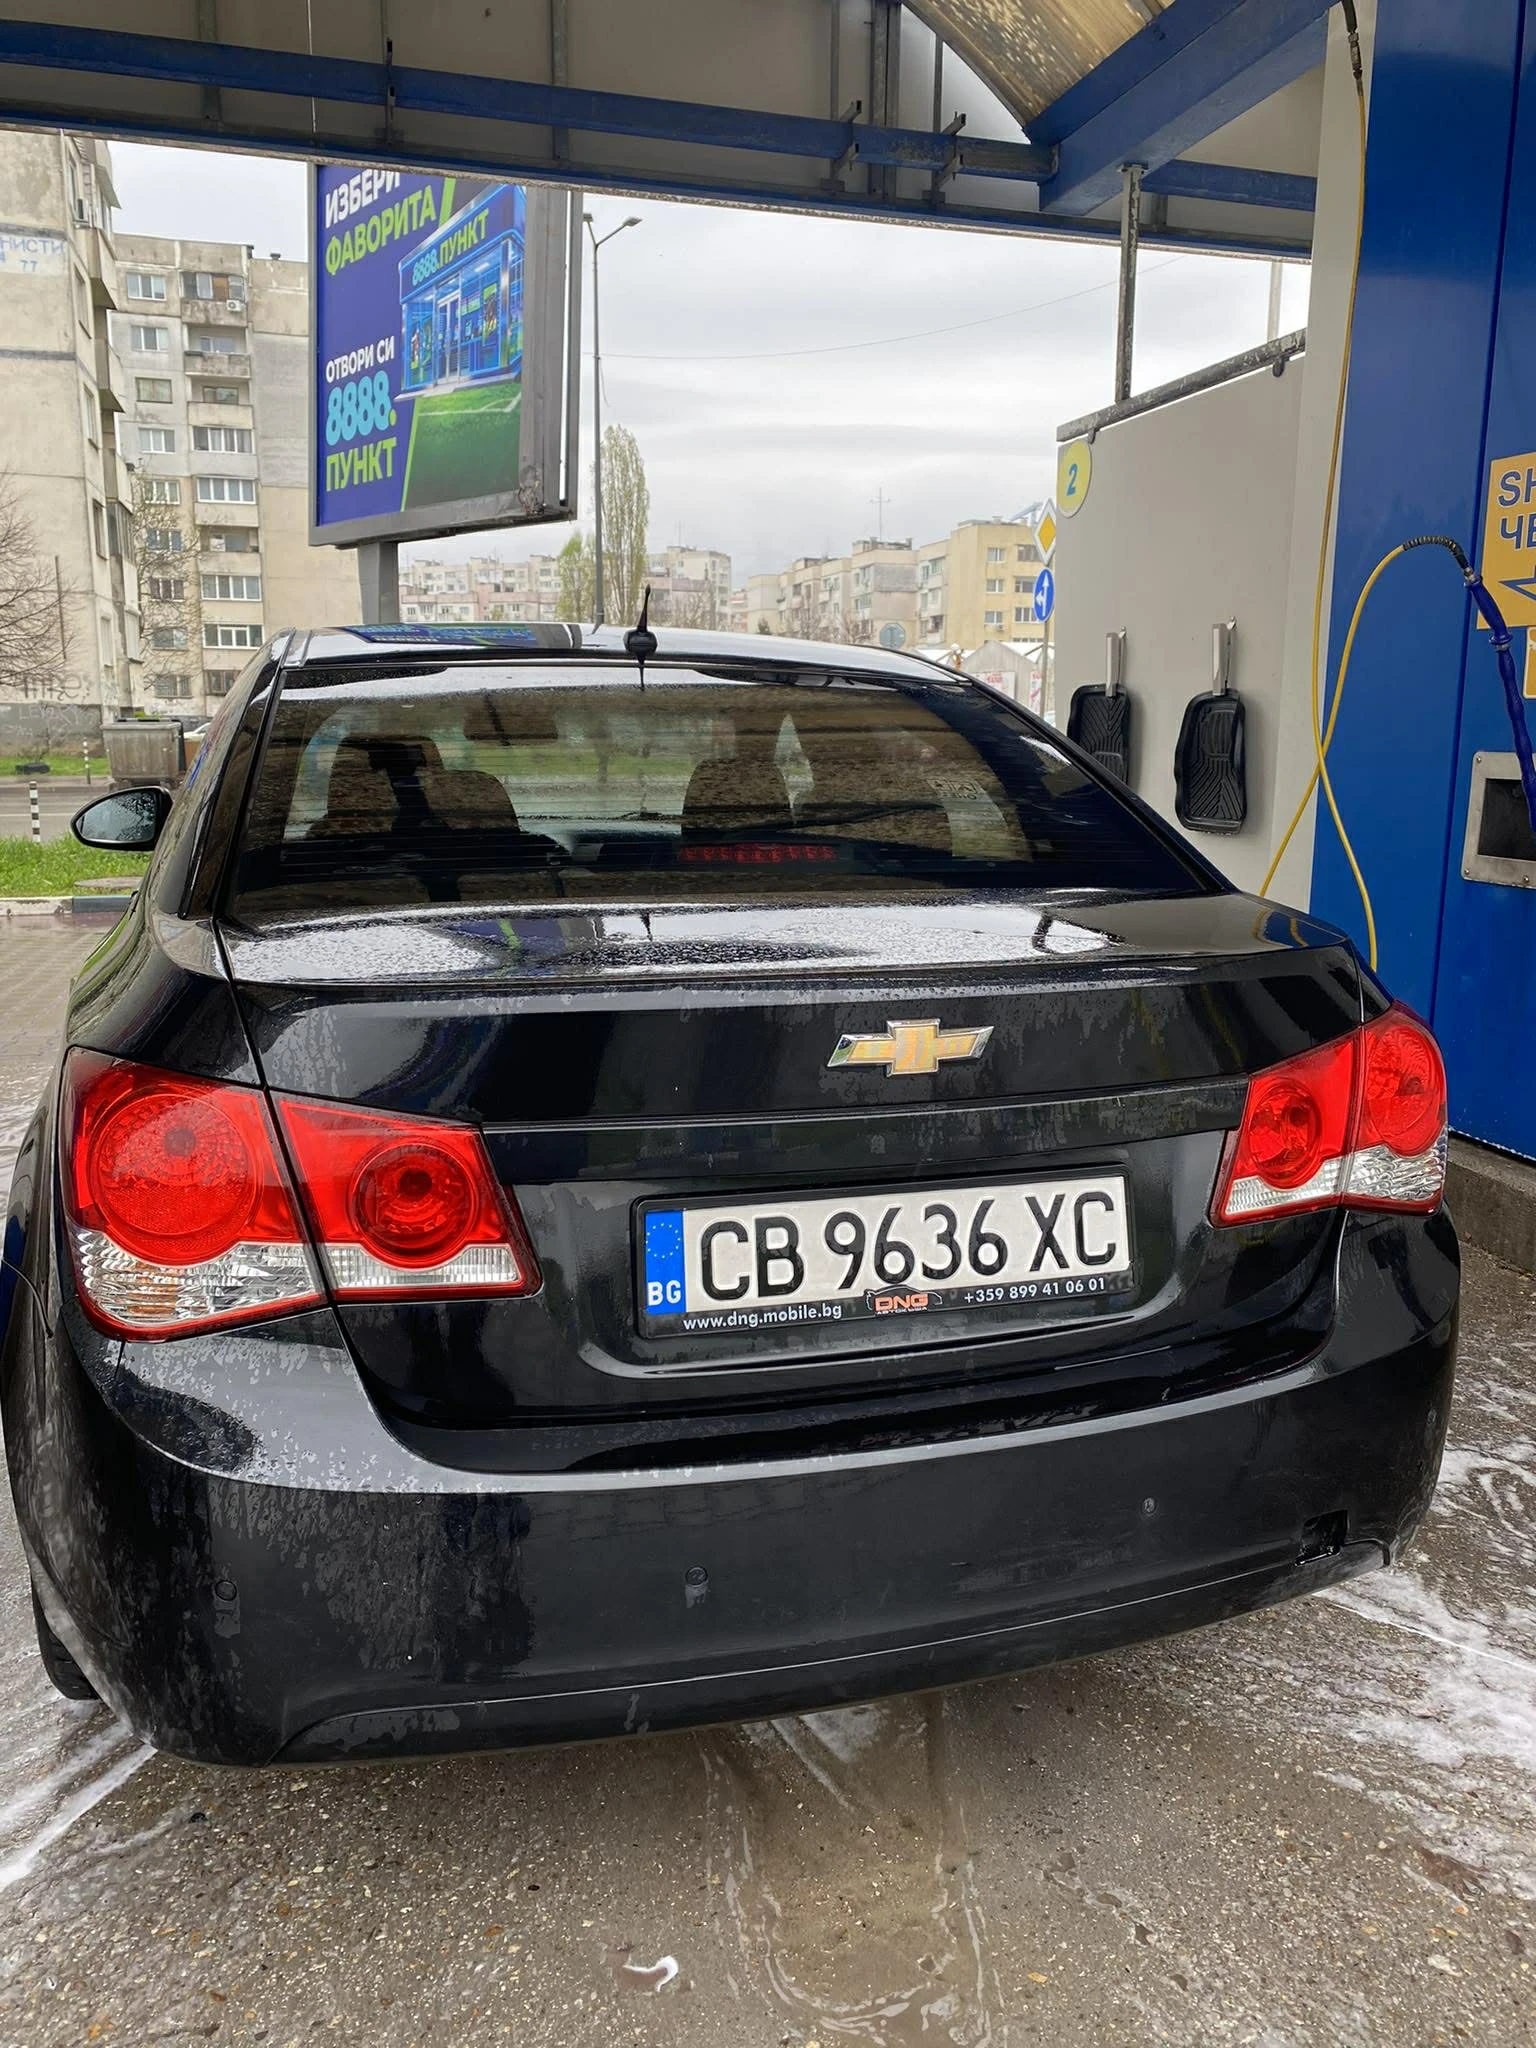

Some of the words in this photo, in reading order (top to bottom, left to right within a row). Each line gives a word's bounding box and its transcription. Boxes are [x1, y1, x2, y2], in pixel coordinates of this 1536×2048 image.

[325, 168, 400, 229] ИЗБЕРИ
[326, 184, 437, 276] ФАВОРИТА
[326, 343, 374, 384] ОТВОРИ
[376, 335, 395, 364] СИ
[326, 370, 397, 446] 8888.
[326, 436, 397, 492] ПУНКТ
[1066, 463, 1079, 497] 2
[701, 1216, 804, 1301] CB
[824, 1199, 1008, 1290] 9636
[1025, 1191, 1116, 1273] XC
[647, 1279, 682, 1306] BG
[875, 1293, 929, 1312] DNG
[964, 1288, 1004, 1304] +359
[1009, 1284, 1038, 1300] 899
[1042, 1282, 1059, 1296] 41
[1065, 1280, 1084, 1293] 06
[1088, 1277, 1105, 1291] 01
[683, 1303, 843, 1331] www.dng.mobile.bg
